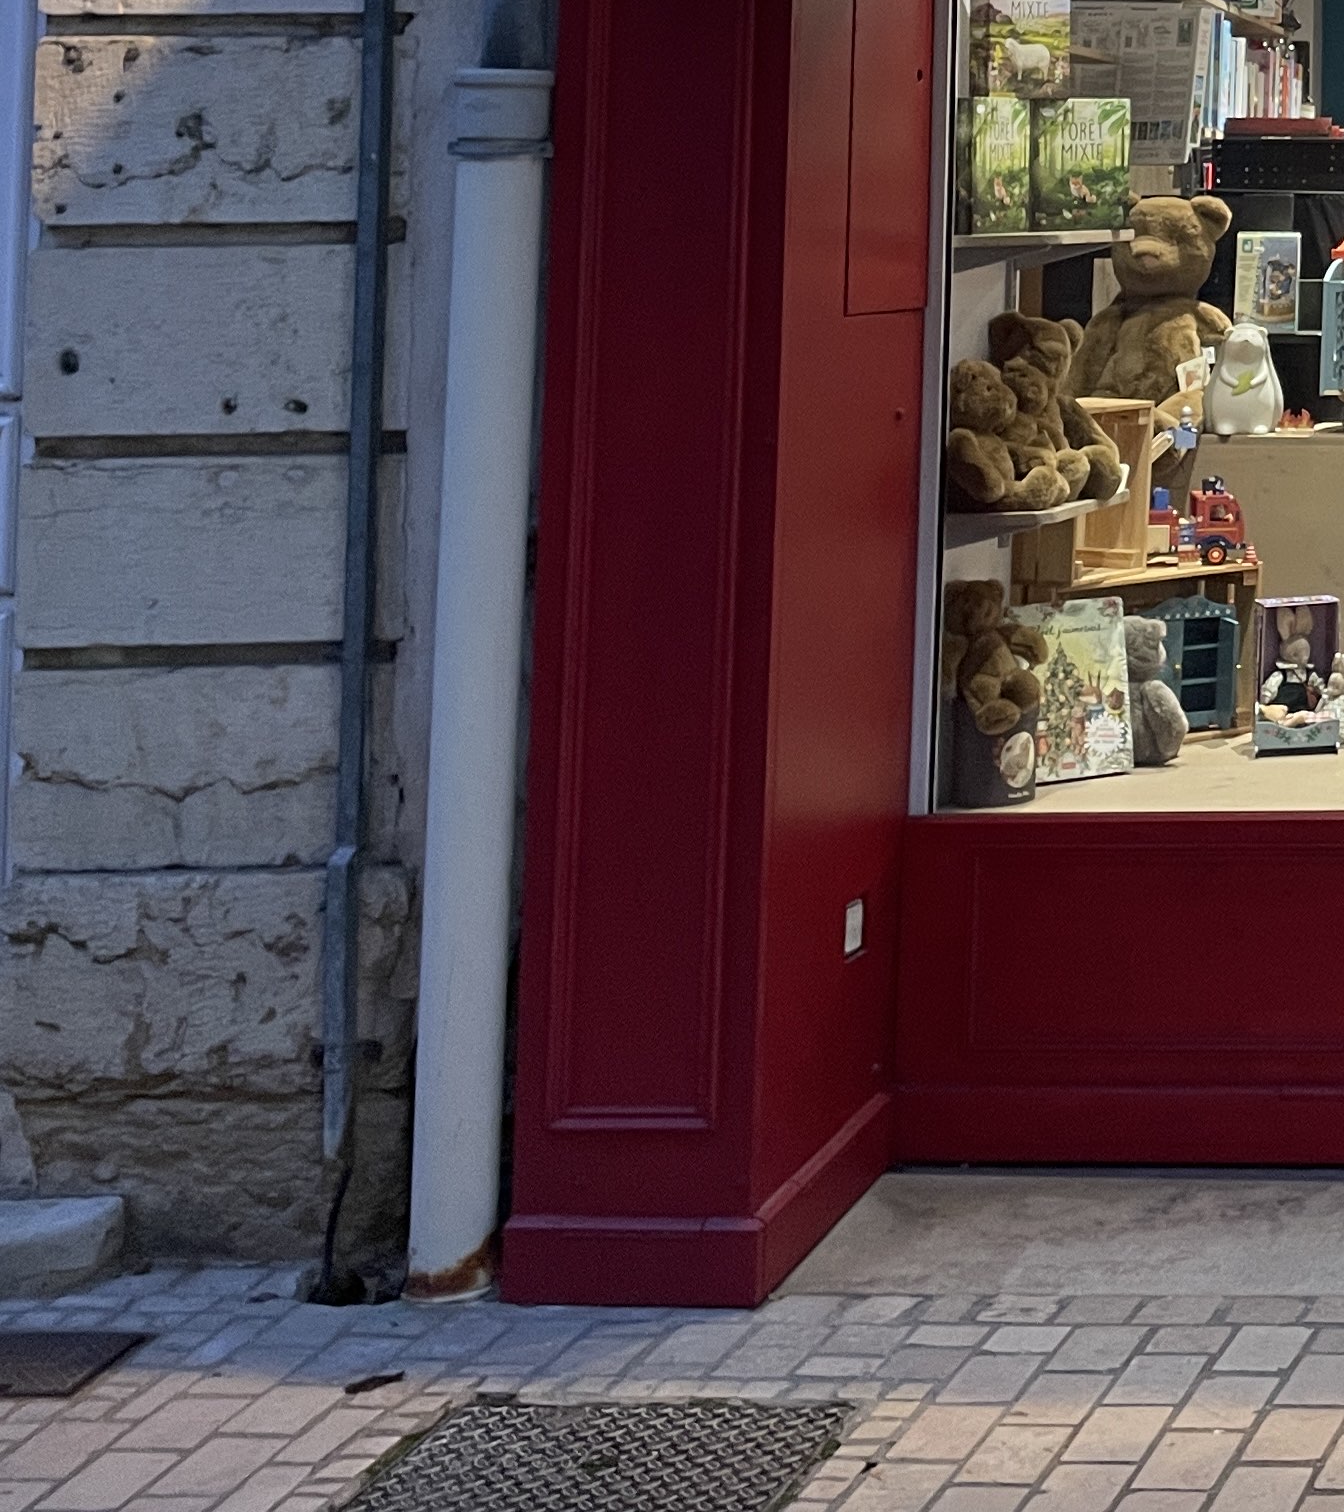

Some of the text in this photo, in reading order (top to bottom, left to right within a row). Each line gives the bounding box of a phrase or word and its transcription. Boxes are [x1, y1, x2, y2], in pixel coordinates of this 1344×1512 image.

[1010, 0, 1049, 20] MIXTE
[1060, 118, 1103, 141] FORÊT
[1061, 142, 1103, 162] MIXTE
